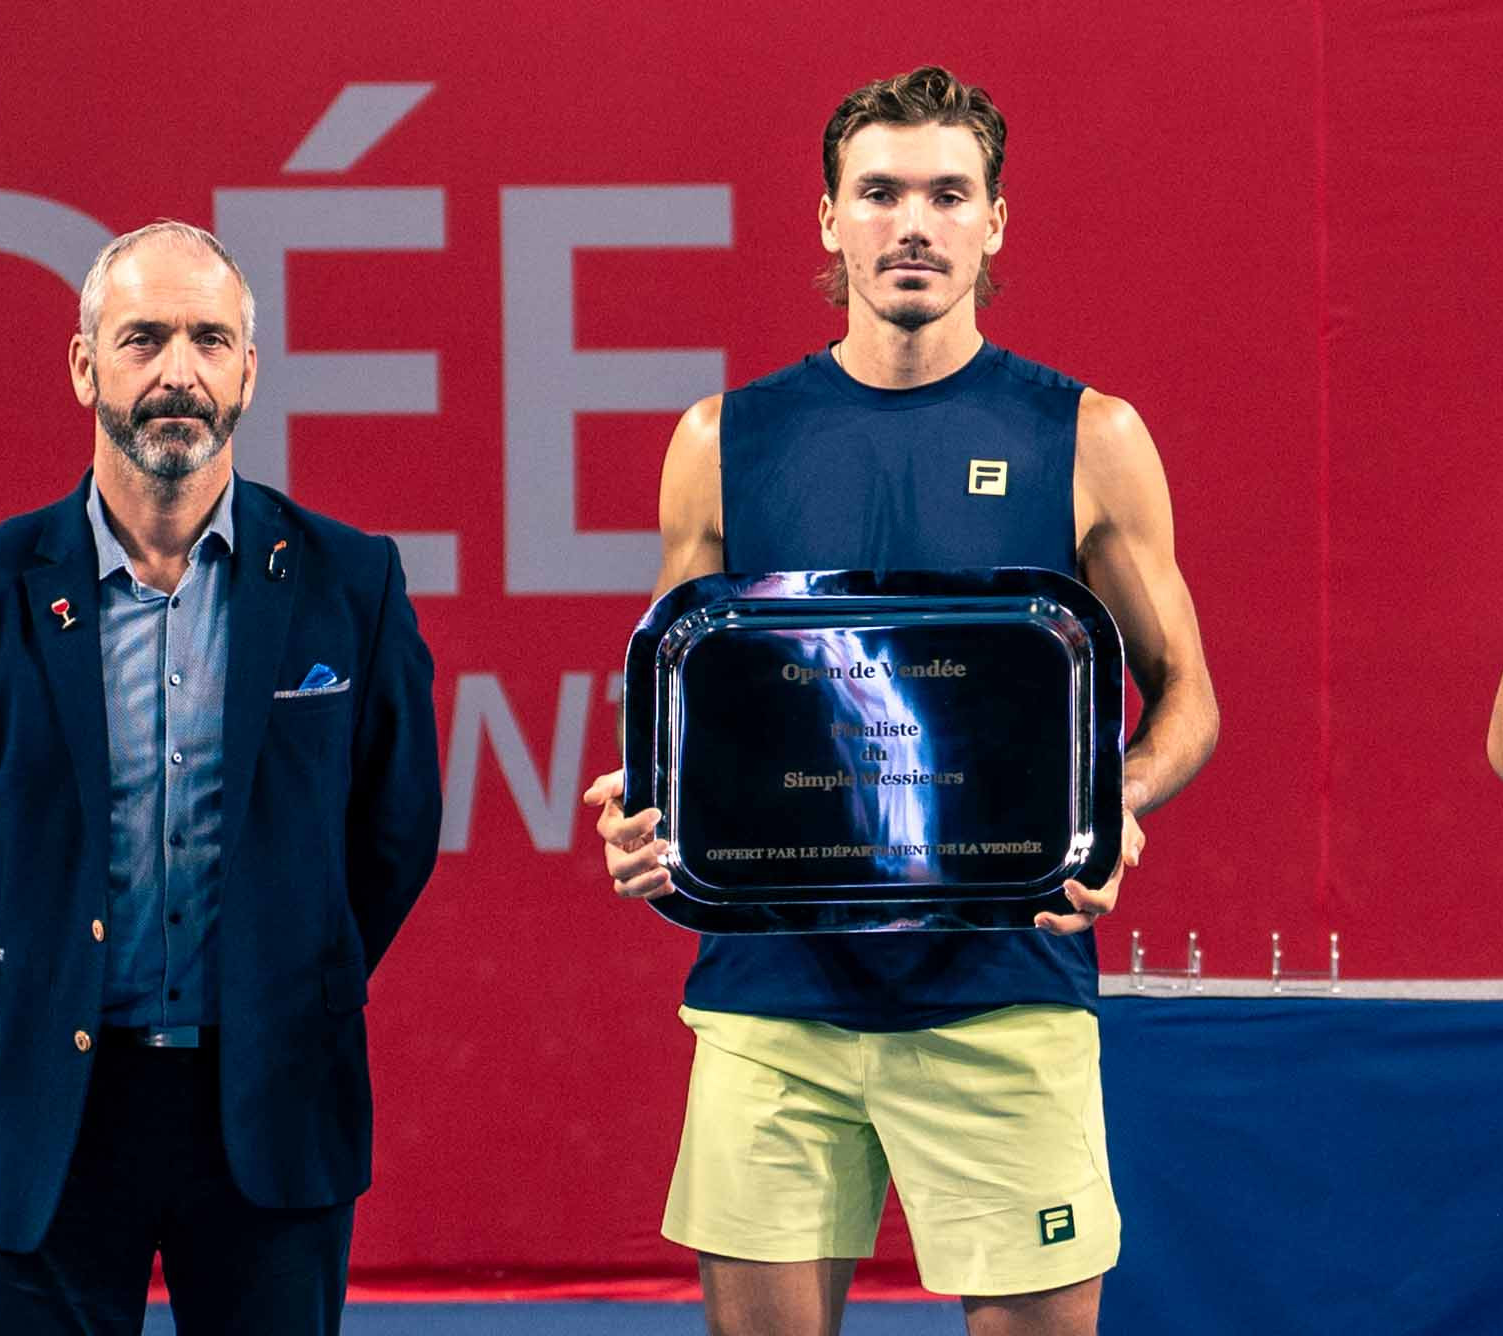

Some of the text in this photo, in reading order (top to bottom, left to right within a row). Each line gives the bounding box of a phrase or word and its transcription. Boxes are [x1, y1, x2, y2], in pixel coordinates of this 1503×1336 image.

[781, 659, 967, 684] Open de Vendée
[832, 721, 919, 738] Finaliste
[861, 743, 889, 762] du
[783, 769, 855, 792] Simple
[706, 847, 765, 861] OFFERT
[767, 846, 797, 860] PAR
[799, 846, 819, 859] LE
[958, 841, 979, 856] LA
[980, 839, 1042, 855] VENDÉE
